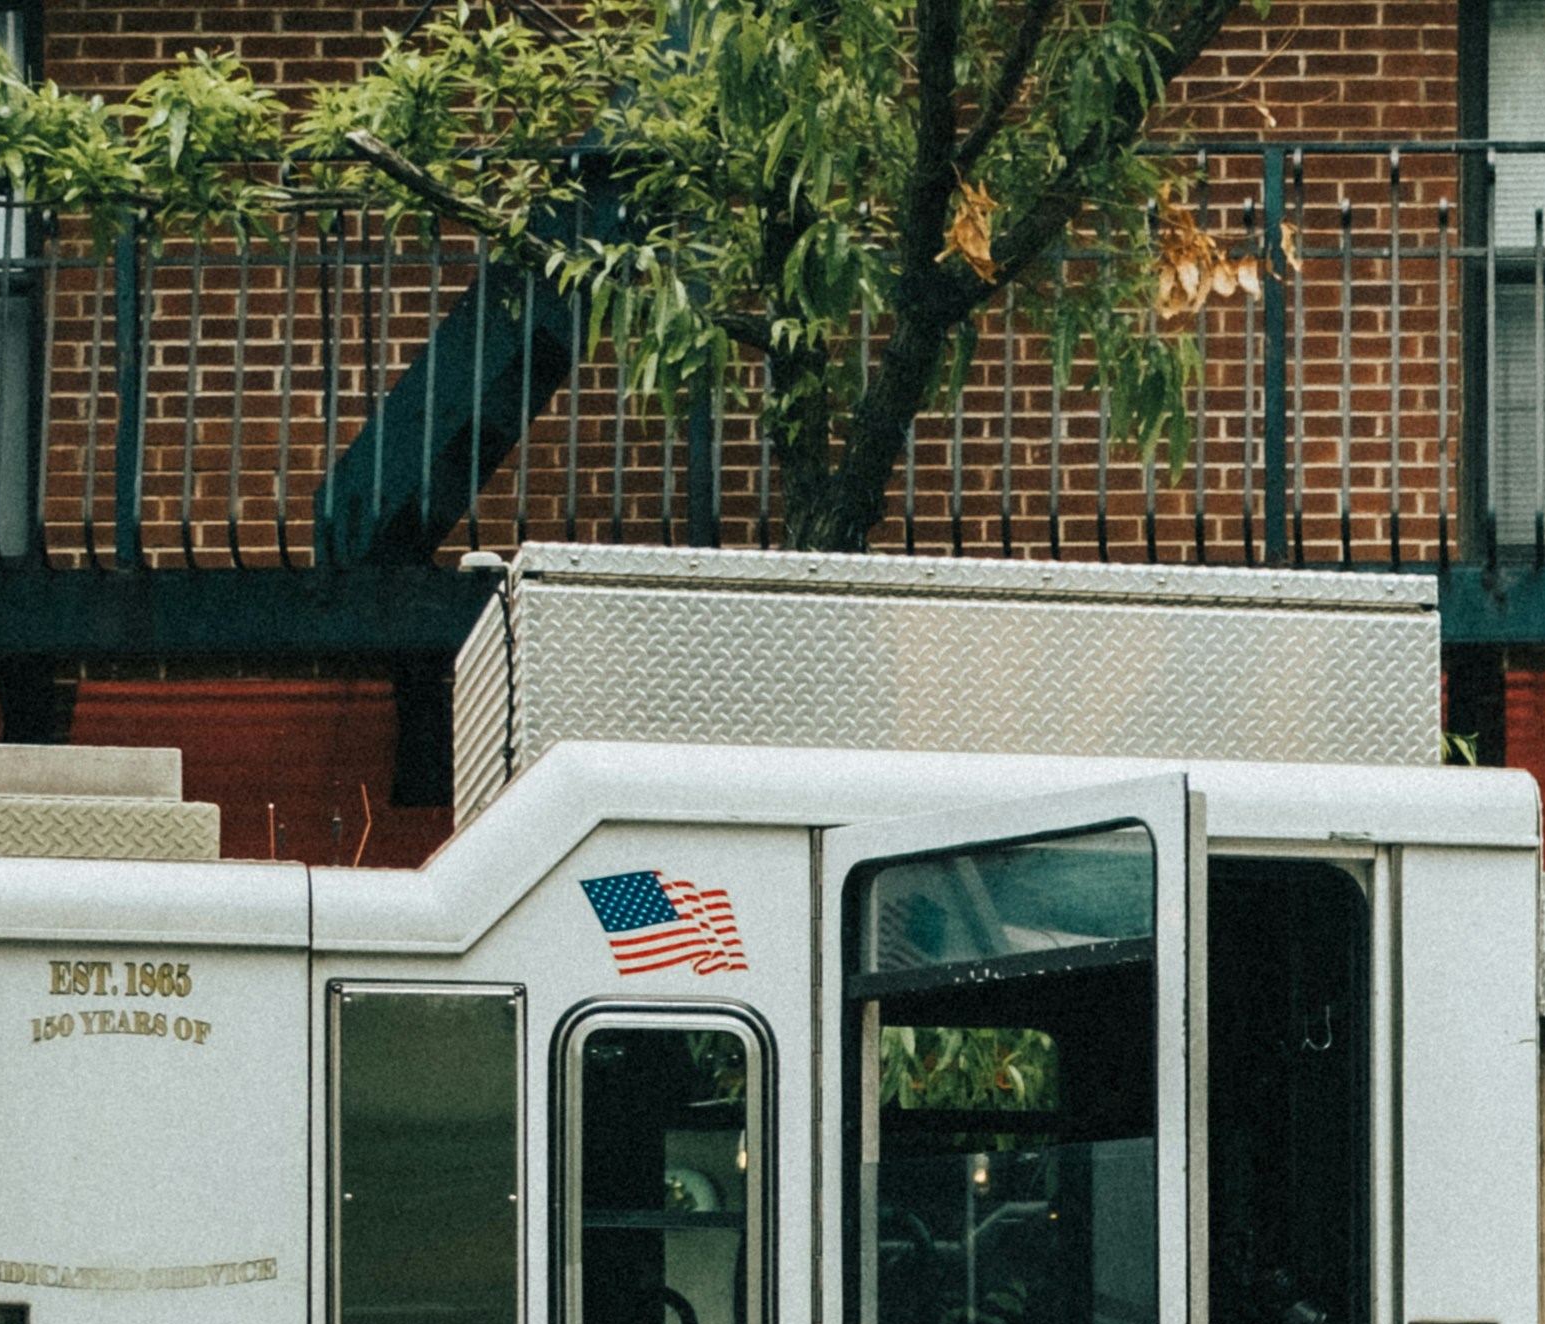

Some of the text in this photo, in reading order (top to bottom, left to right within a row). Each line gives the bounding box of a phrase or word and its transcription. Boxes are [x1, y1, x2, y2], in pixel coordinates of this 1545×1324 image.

[49, 960, 193, 998] EST. 1865
[30, 1010, 212, 1045] 150 YEARS OF
[145, 1257, 278, 1290] SERVICE
